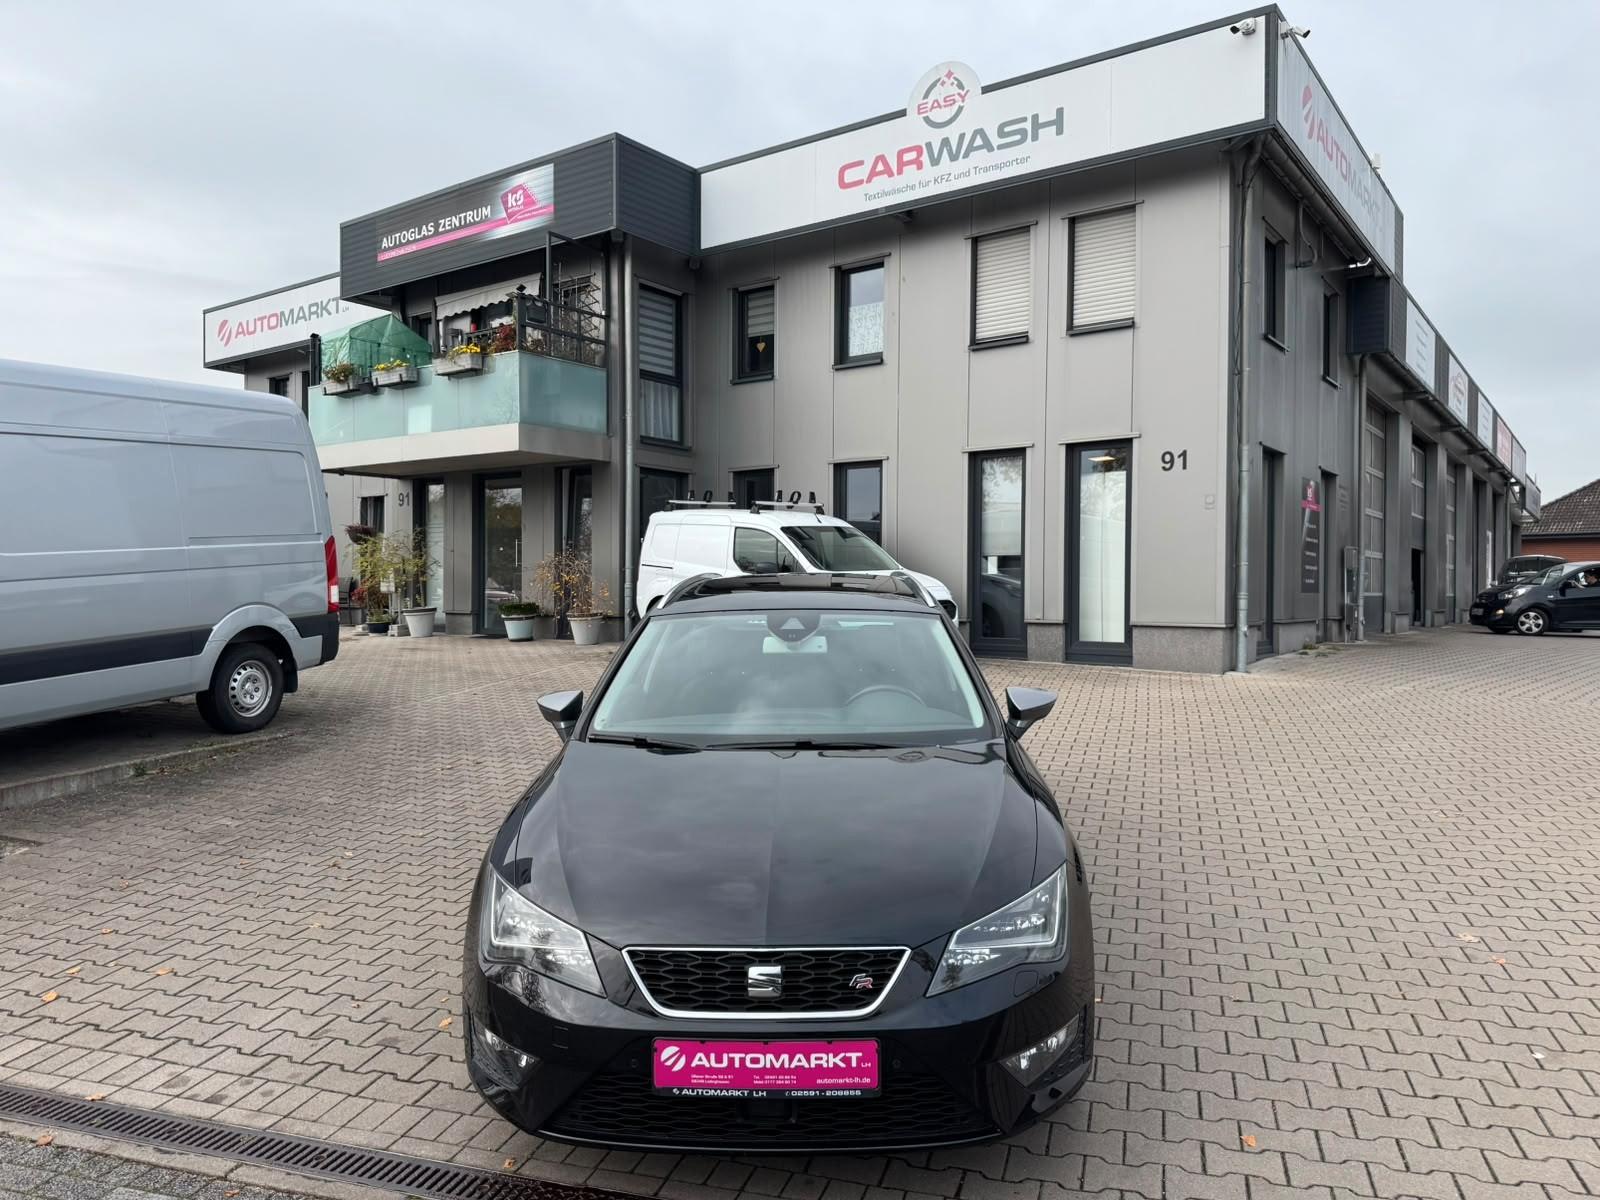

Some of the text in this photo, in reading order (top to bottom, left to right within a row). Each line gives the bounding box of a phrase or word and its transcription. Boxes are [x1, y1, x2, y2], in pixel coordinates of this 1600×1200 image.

[916, 89, 970, 116] EASY
[838, 107, 1064, 190] CARWASH
[863, 155, 1031, 202] Textilwäsche für KFZ und Transporter
[381, 222, 435, 249] AUTOGLAS
[438, 204, 491, 232] ZENTRUM
[234, 298, 341, 339] AUTOMARKT
[1161, 449, 1187, 472] 91
[398, 491, 410, 507] 91
[690, 1052, 862, 1069] AUTOMARKT
[681, 1088, 749, 1097] AUTOMARKT
[816, 1077, 871, 1085] automarkt-lh.de
